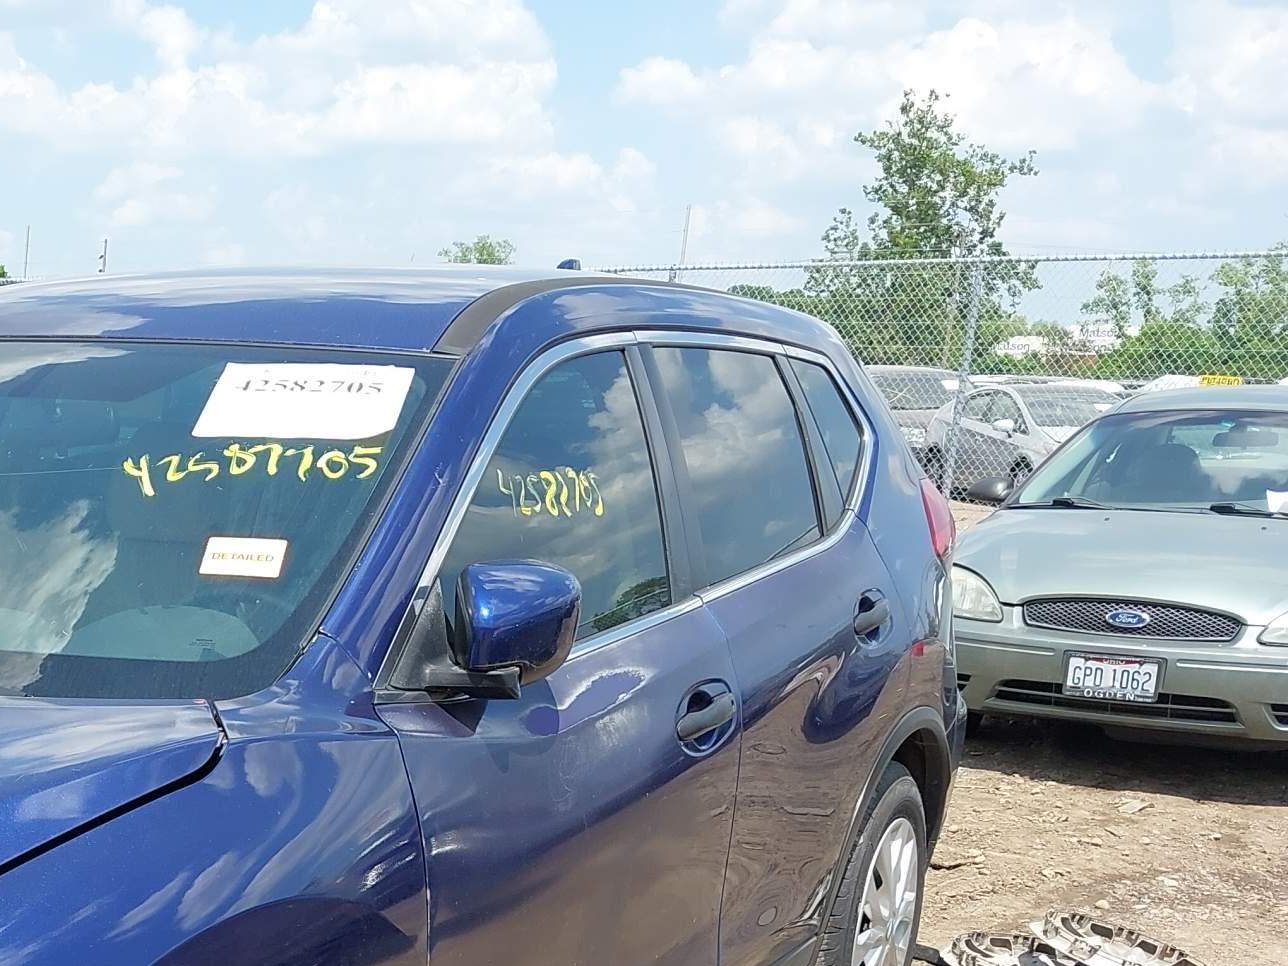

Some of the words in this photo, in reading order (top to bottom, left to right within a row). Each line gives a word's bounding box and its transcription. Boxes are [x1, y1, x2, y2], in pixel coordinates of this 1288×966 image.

[235, 379, 385, 395] 42582705
[211, 552, 275, 563] DETAILED
[1115, 613, 1139, 624] Ford
[1112, 668, 1152, 692] 1062
[1083, 688, 1136, 701] OGDEN
